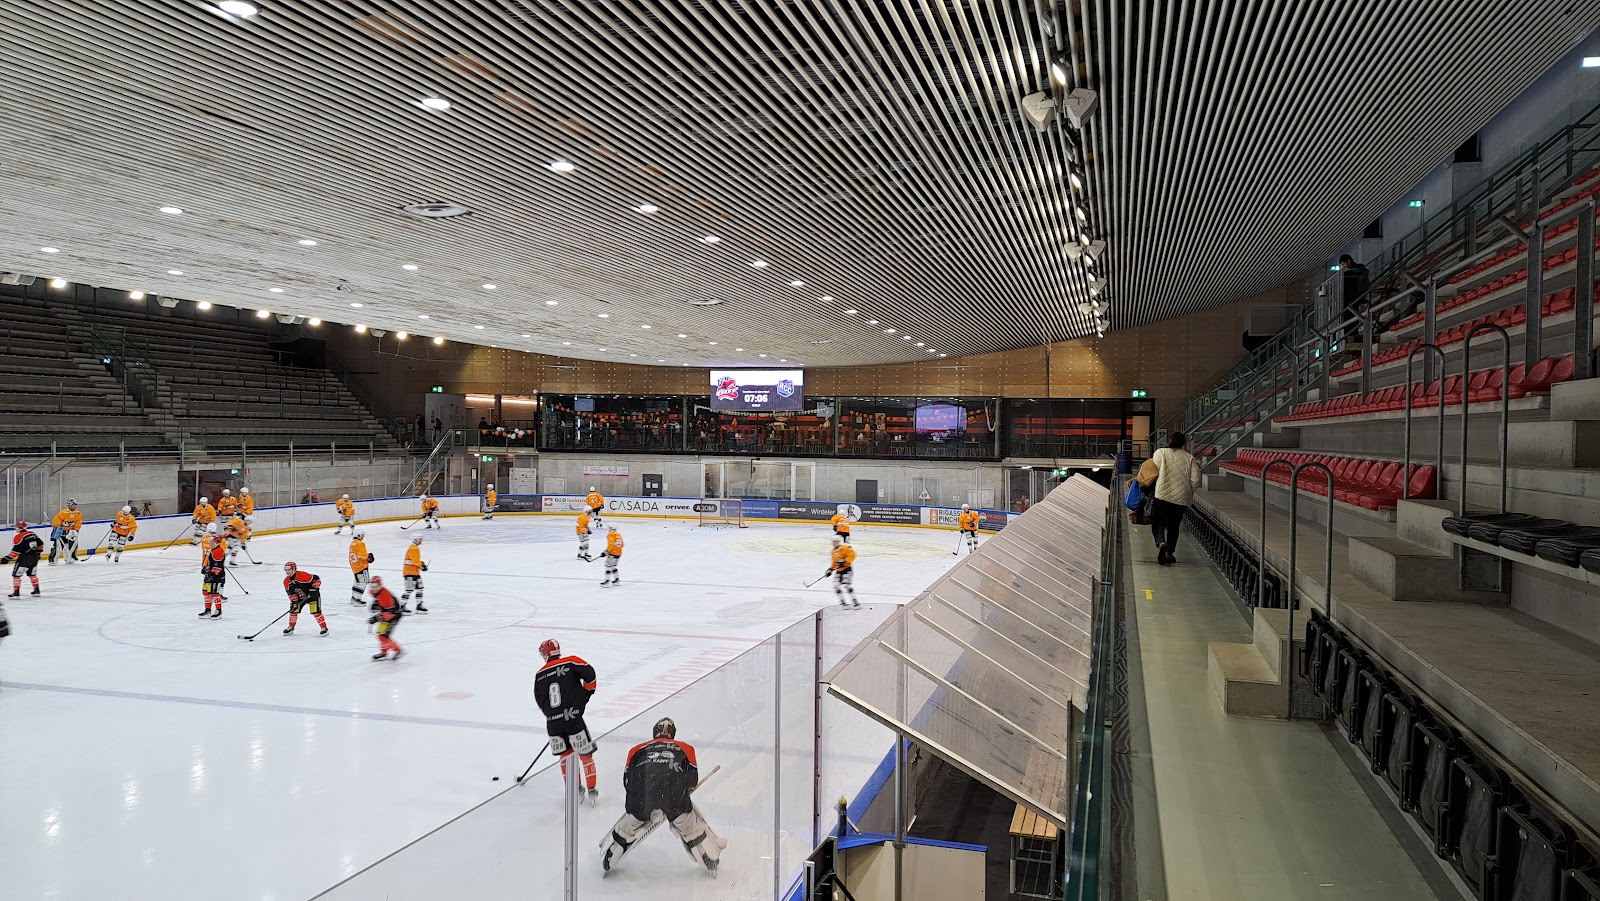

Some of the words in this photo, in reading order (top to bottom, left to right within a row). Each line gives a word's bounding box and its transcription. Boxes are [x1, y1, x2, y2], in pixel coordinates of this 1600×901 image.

[609, 500, 659, 511] CASADA
[810, 507, 836, 516] Winteler
[548, 681, 562, 709] 8
